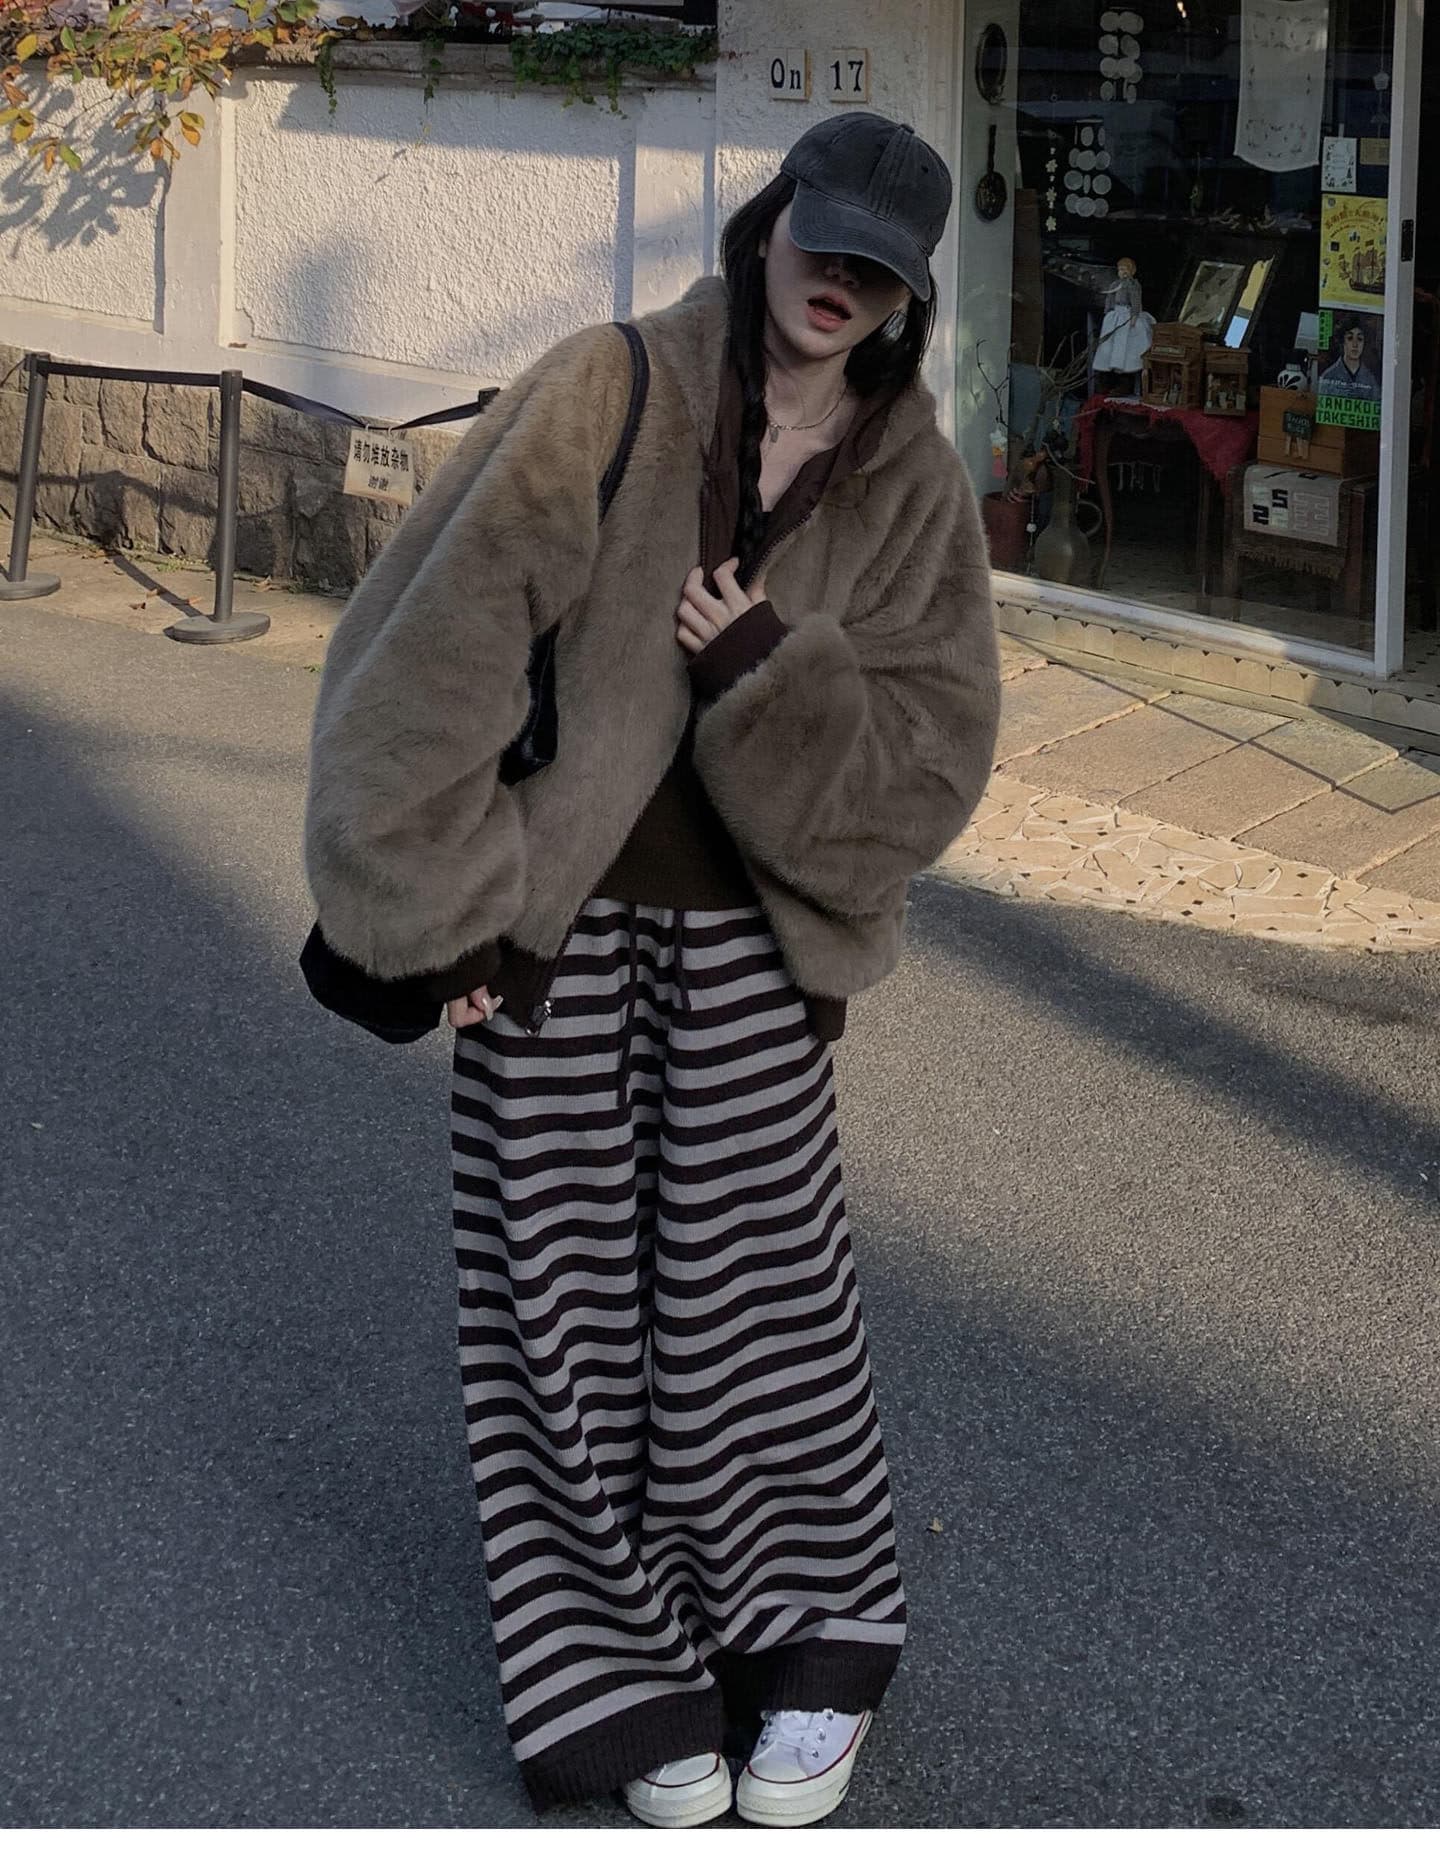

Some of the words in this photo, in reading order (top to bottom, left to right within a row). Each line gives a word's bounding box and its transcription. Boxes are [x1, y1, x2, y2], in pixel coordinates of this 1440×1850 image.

[770, 58, 802, 90] On
[830, 59, 864, 92] 17
[353, 440, 410, 473] 请勿堆放杂物
